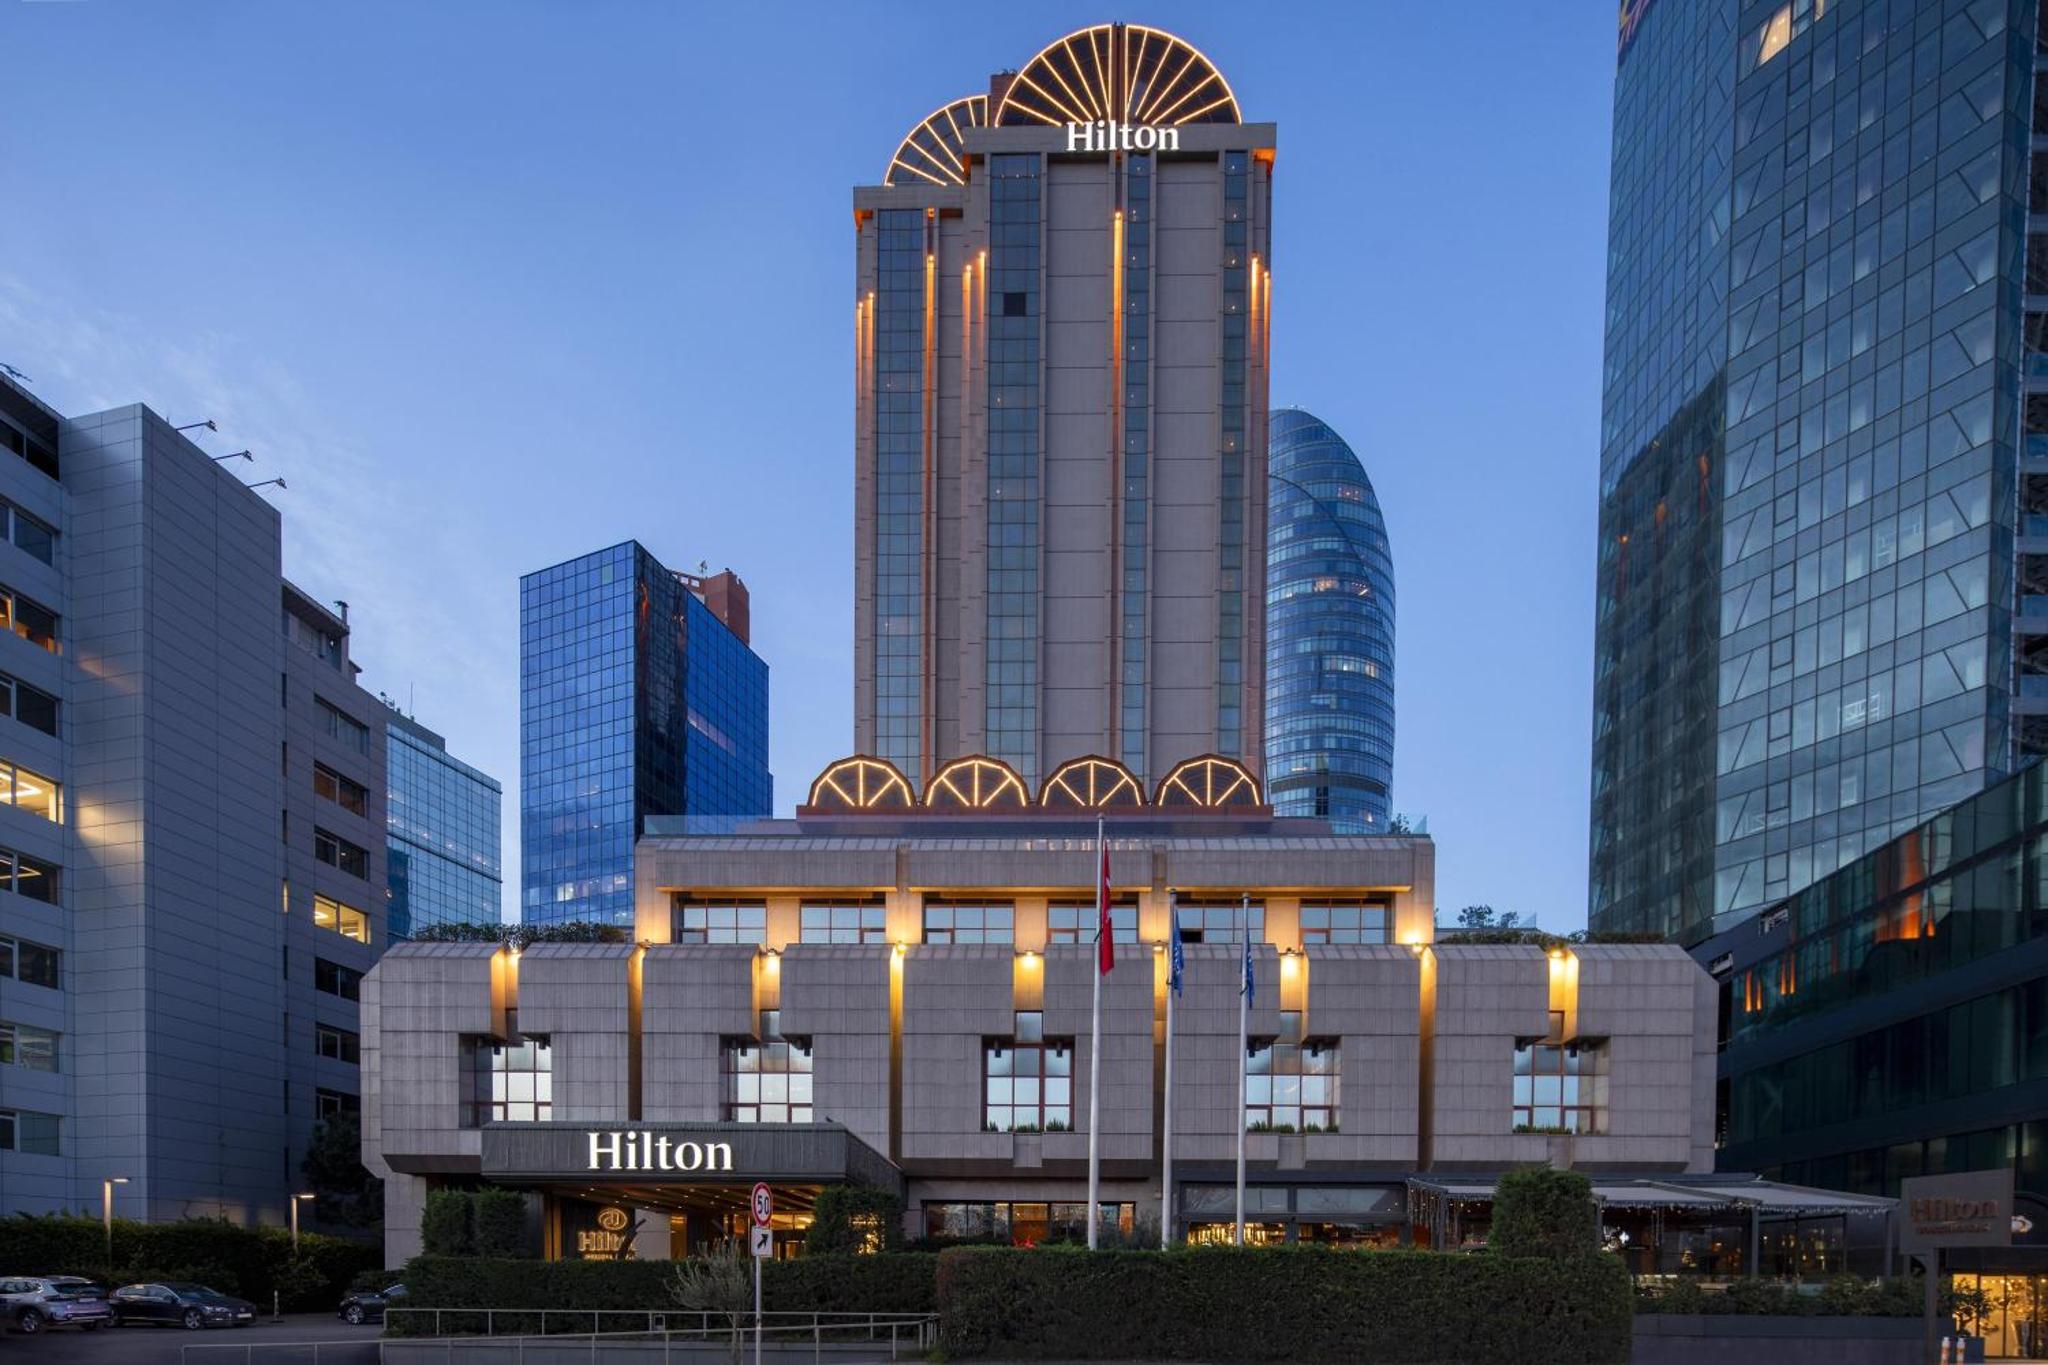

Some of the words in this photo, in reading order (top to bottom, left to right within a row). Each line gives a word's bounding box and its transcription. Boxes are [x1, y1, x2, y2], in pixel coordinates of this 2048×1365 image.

[1066, 119, 1180, 151] Hilton
[587, 1131, 734, 1171] Hilton
[757, 1195, 770, 1215] 50
[1910, 1197, 2000, 1222] Hilton
